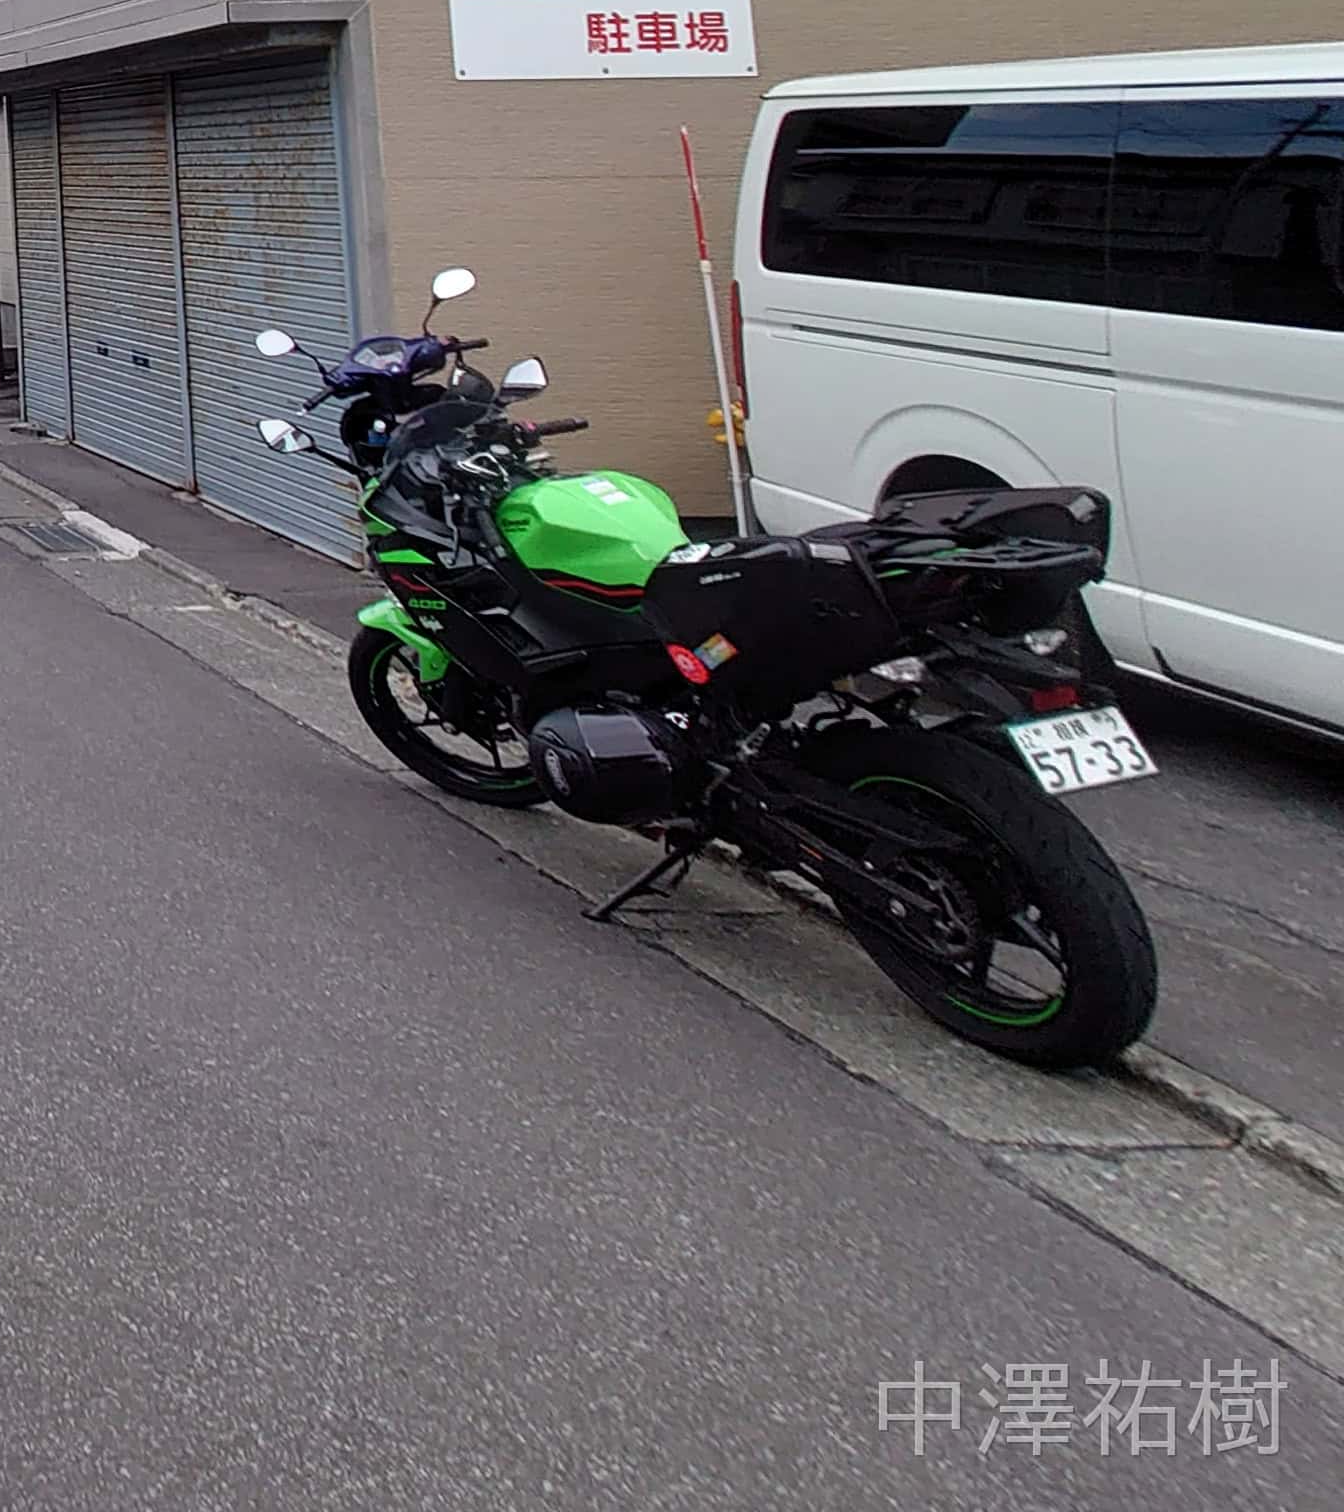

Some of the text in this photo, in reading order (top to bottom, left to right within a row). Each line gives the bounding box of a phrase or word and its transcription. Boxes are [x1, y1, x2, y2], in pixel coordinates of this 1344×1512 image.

[586, 11, 729, 55] 駐車場
[1032, 735, 1146, 788] 57-33
